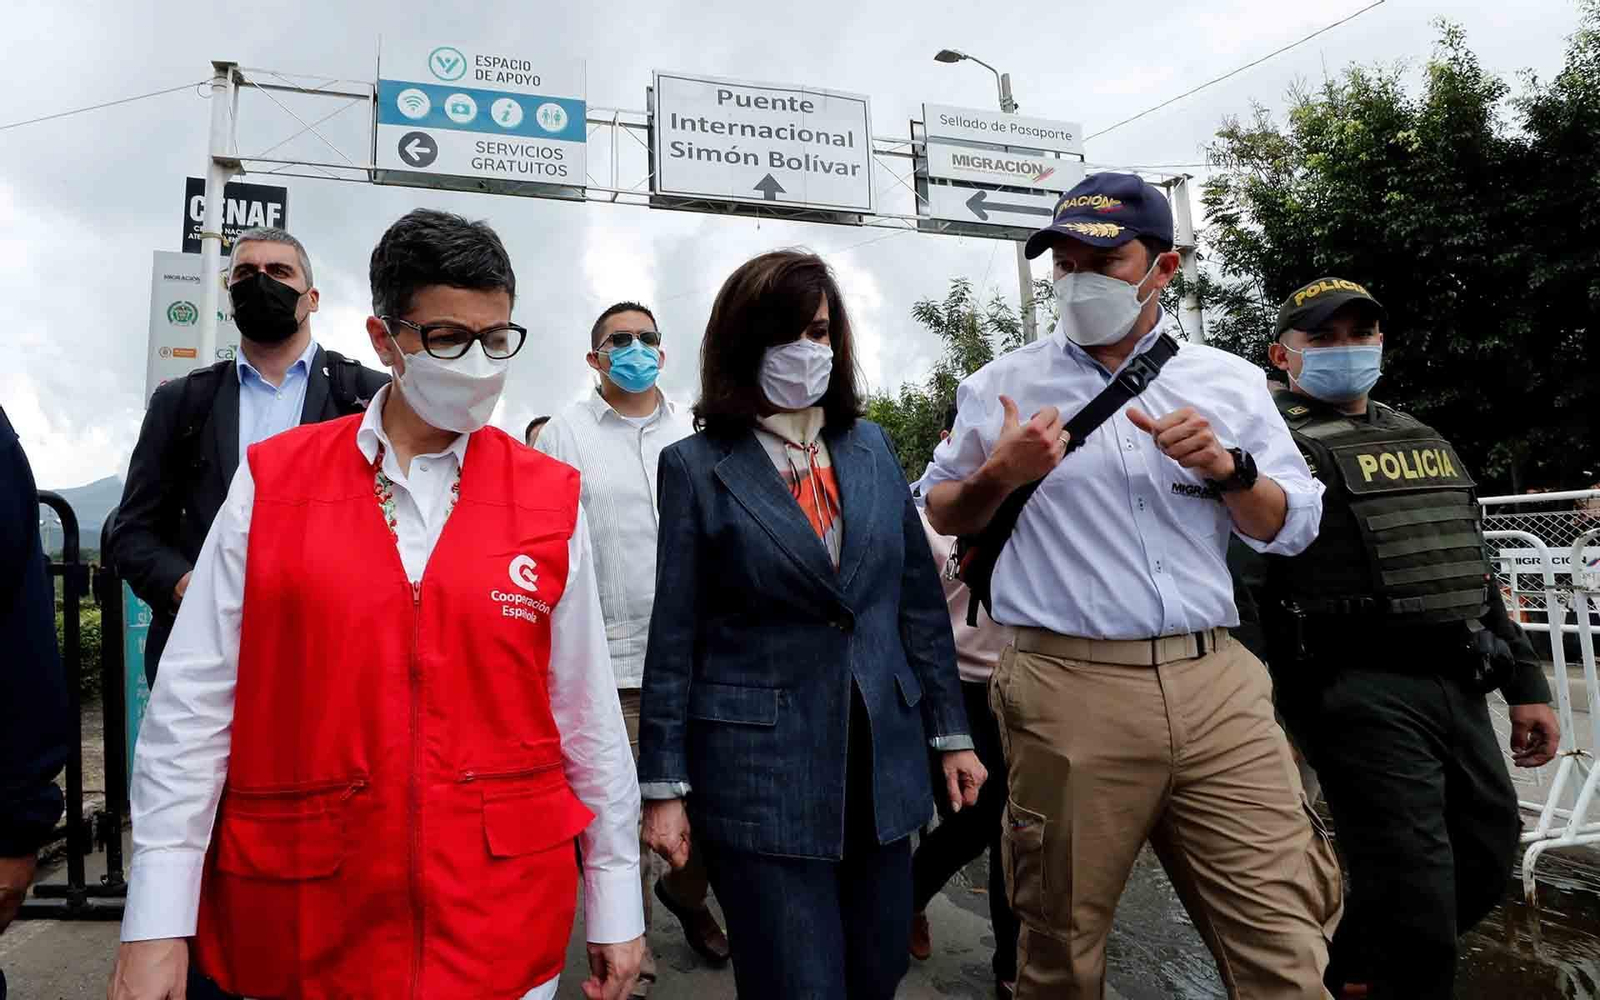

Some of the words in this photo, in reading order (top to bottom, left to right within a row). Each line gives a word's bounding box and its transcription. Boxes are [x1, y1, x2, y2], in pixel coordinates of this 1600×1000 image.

[475, 54, 532, 72] ESPACIO
[475, 68, 493, 81] DE
[496, 71, 541, 87] APOYO
[716, 89, 815, 114] Puente
[670, 112, 854, 149] Internacional
[939, 113, 987, 130] Sellado
[991, 121, 1007, 133] de
[1010, 123, 1073, 142] Pasaporte
[475, 140, 564, 161] SERVICIOS
[669, 141, 760, 167] Simón
[768, 150, 861, 177] Bolívar
[471, 157, 568, 177] GRATUITOS
[952, 152, 1043, 175] MIGRACIÓN
[190, 195, 281, 228] CNAF
[1357, 448, 1459, 482] POLICIA
[1171, 482, 1210, 496] MIGRA
[490, 590, 551, 615] Cooperación
